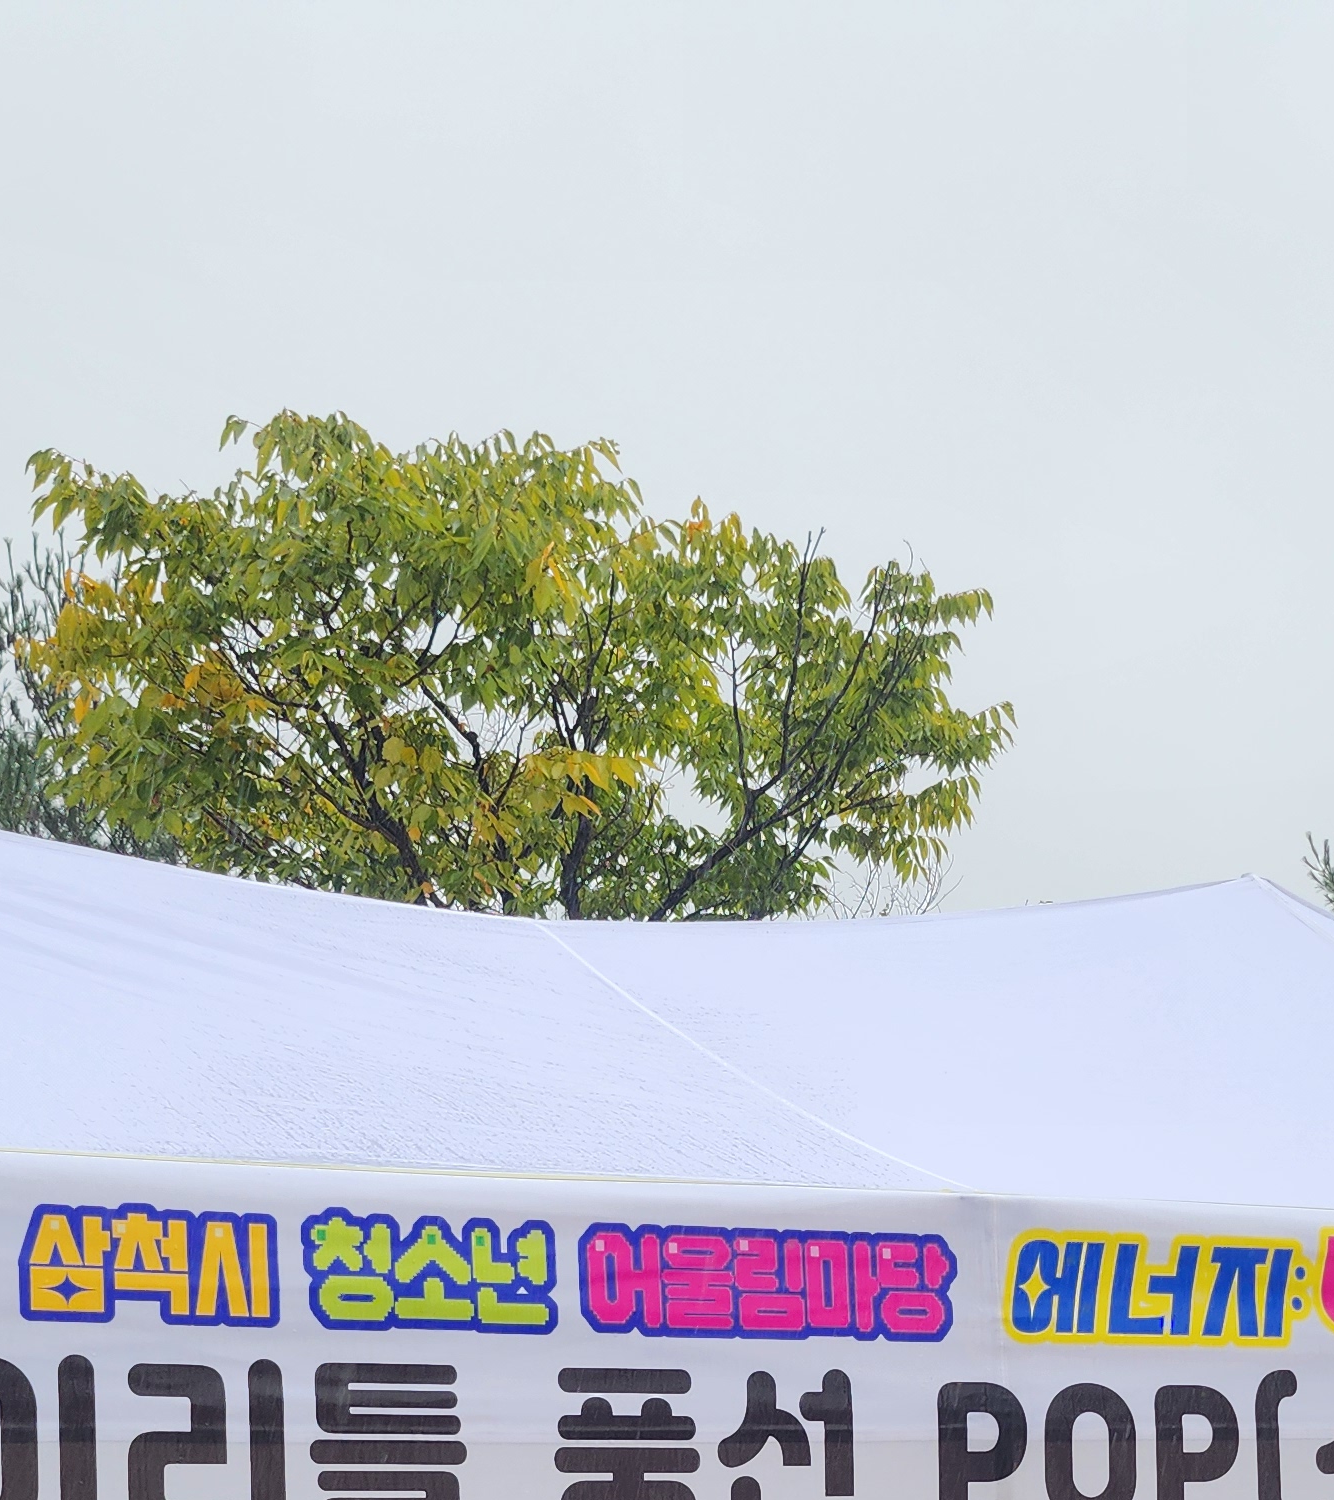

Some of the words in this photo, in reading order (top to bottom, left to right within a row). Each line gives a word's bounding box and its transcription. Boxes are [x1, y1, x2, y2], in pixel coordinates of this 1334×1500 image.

[18, 1203, 281, 1328] 삼척시
[301, 1206, 558, 1335] 청소년
[578, 1222, 959, 1343] 어울림마당
